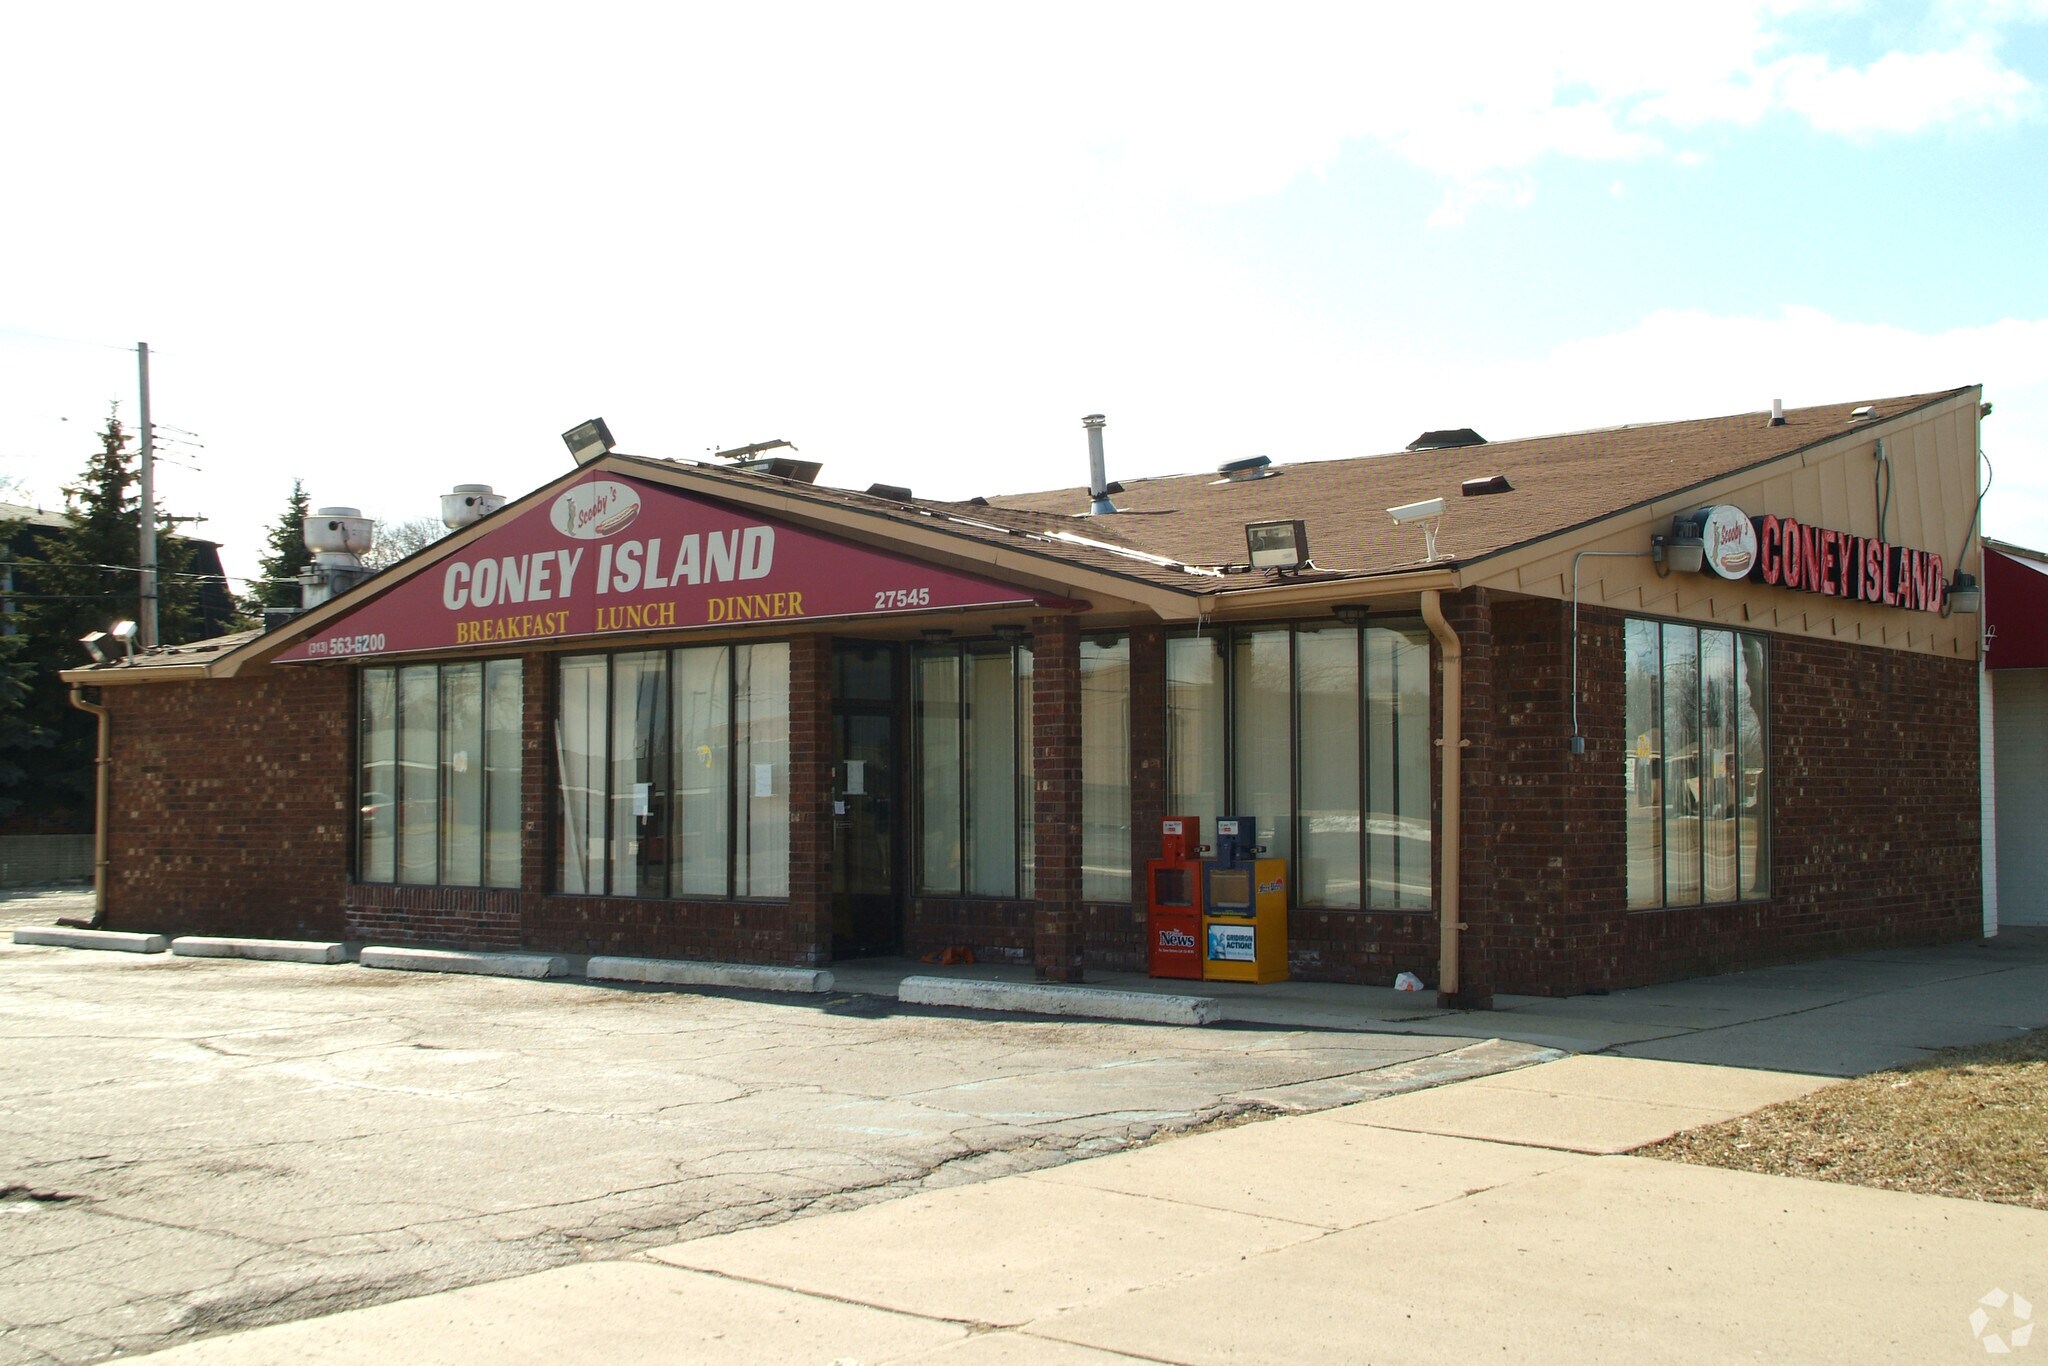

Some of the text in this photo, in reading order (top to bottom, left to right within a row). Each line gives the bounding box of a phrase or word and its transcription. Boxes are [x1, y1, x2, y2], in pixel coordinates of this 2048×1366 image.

[443, 525, 776, 611] CONEY ISLAND
[1762, 514, 1943, 613] CONEY ISLAND
[874, 587, 930, 609] 27545
[456, 591, 805, 644] BREAKFAST LUNCH DINNER
[308, 633, 386, 655] (313) 563-6200
[1159, 931, 1195, 948] News
